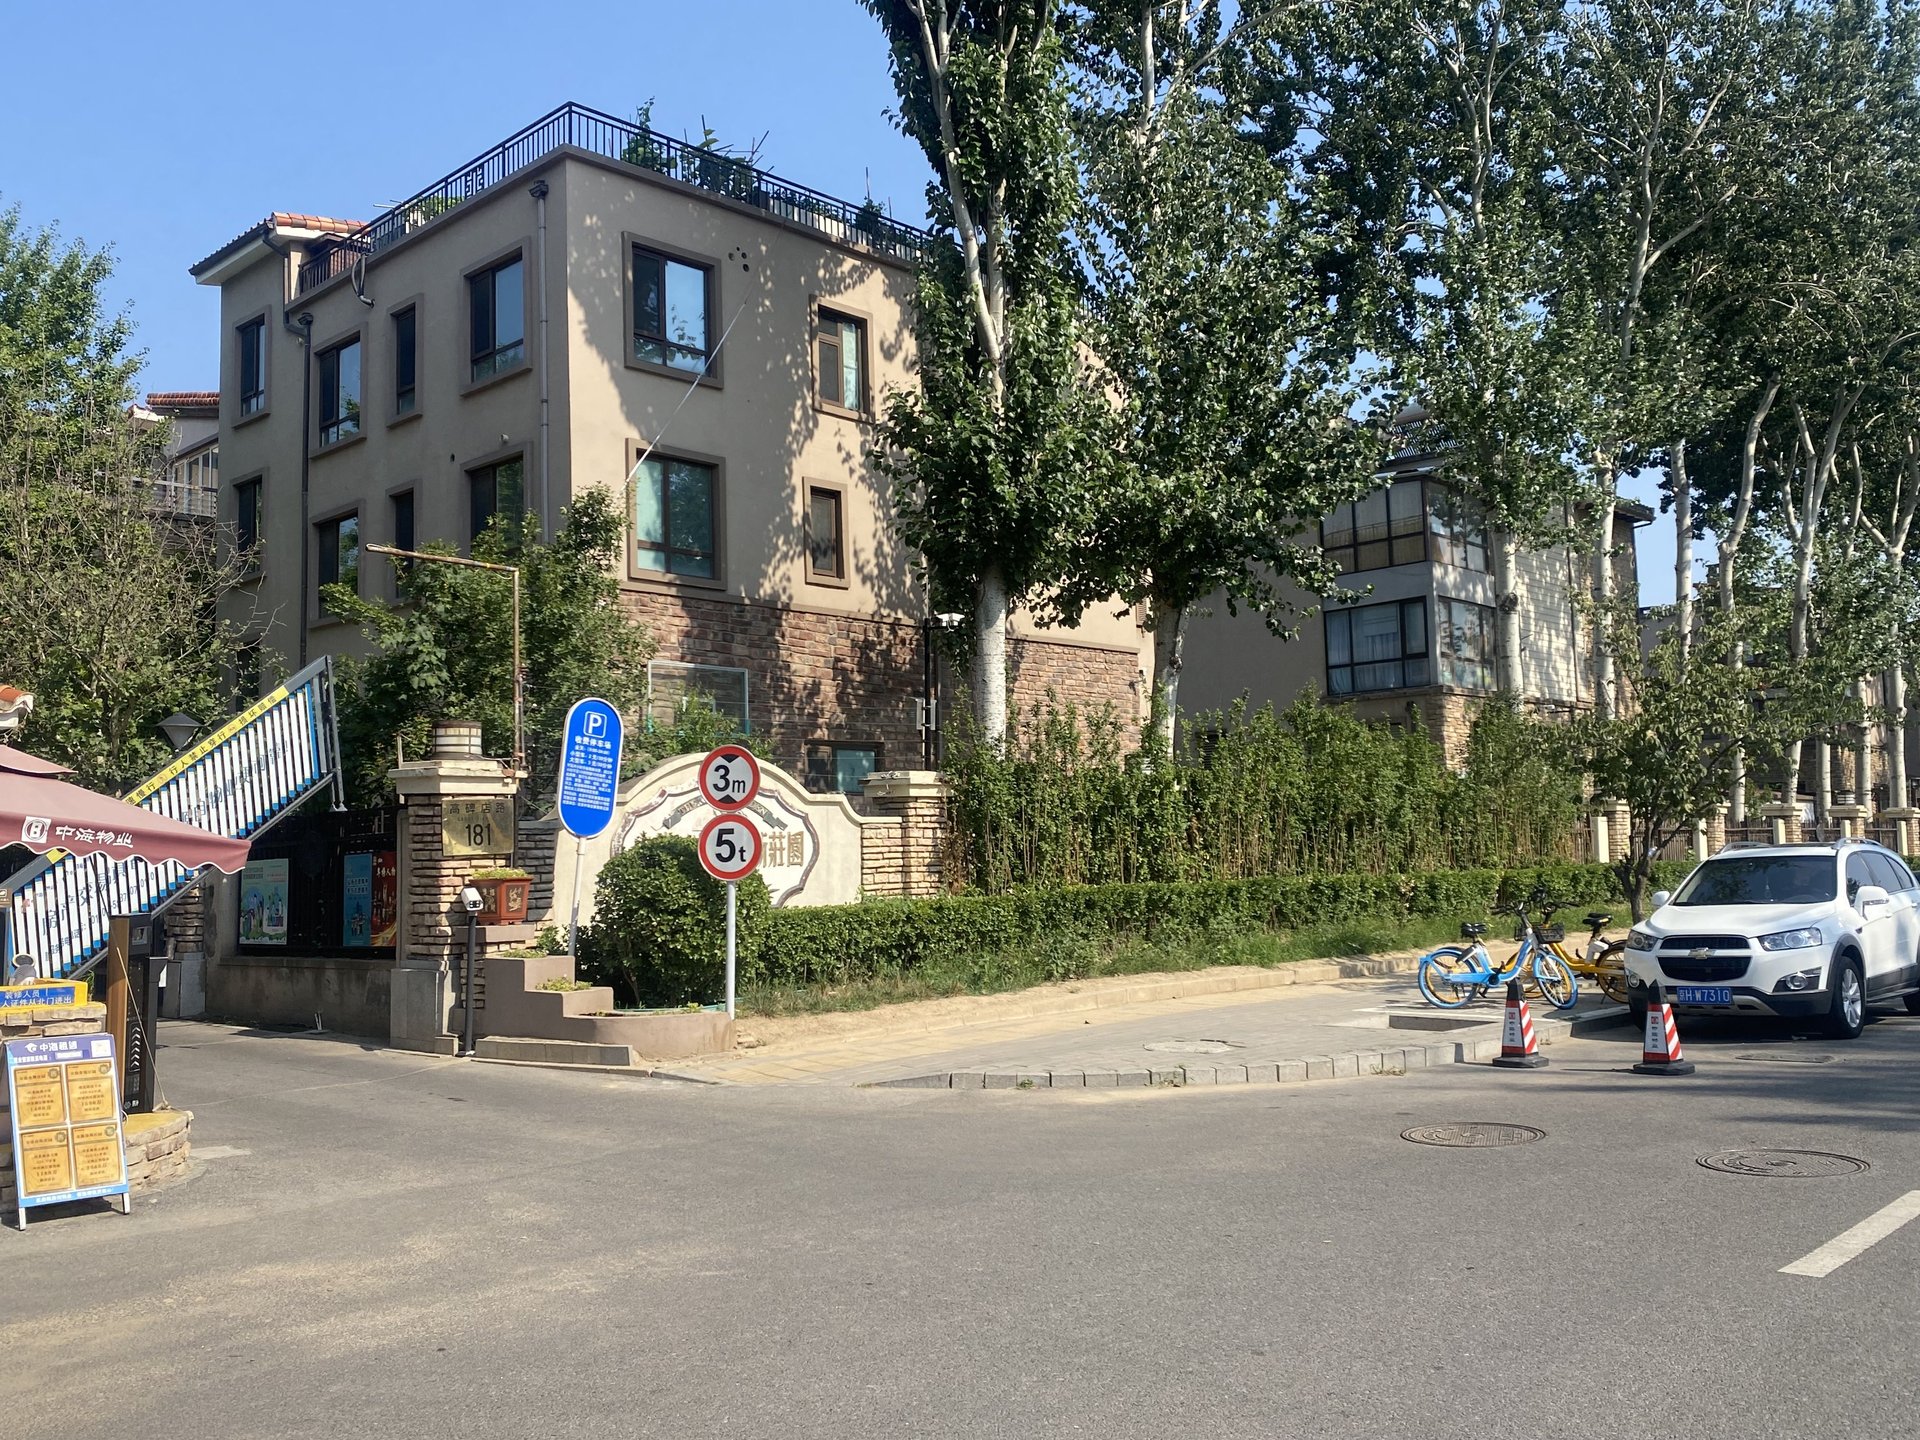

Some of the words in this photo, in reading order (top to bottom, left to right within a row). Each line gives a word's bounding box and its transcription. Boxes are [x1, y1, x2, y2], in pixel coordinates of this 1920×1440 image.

[587, 713, 603, 735] P
[574, 736, 612, 750] 收费停车场
[712, 764, 746, 794] 3m
[449, 802, 506, 815] 高碑店路
[55, 825, 134, 849] 中海物业
[465, 823, 492, 847] 181
[714, 828, 747, 863] 5t
[4, 989, 40, 999] 装修人员
